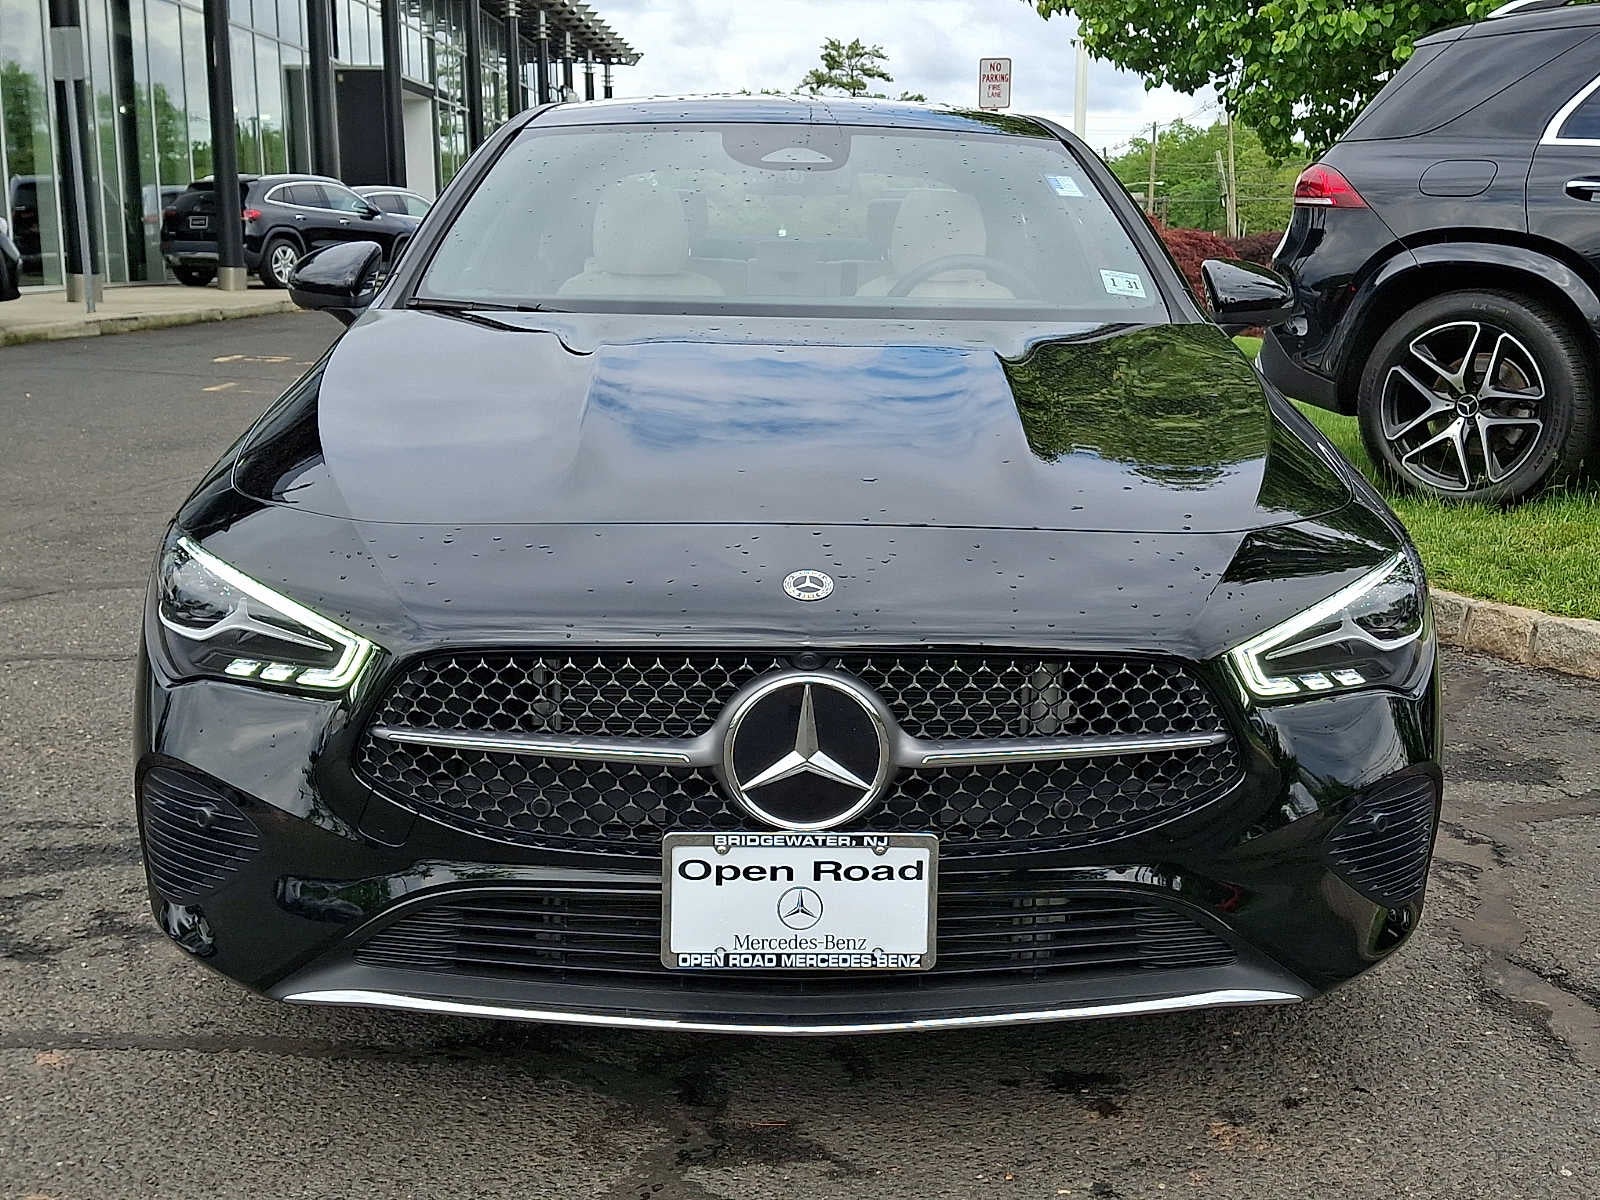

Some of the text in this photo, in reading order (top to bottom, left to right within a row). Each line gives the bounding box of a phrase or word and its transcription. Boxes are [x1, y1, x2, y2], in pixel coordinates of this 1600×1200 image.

[989, 62, 1002, 72] NO
[982, 73, 1009, 83] PARKING
[714, 835, 888, 847] BRIDGEWATER, NJ
[678, 859, 923, 886] Open Road
[733, 934, 867, 951] Mercedes-Benz
[678, 954, 921, 968] OPEN ROAD MERCEDES-BENZ
